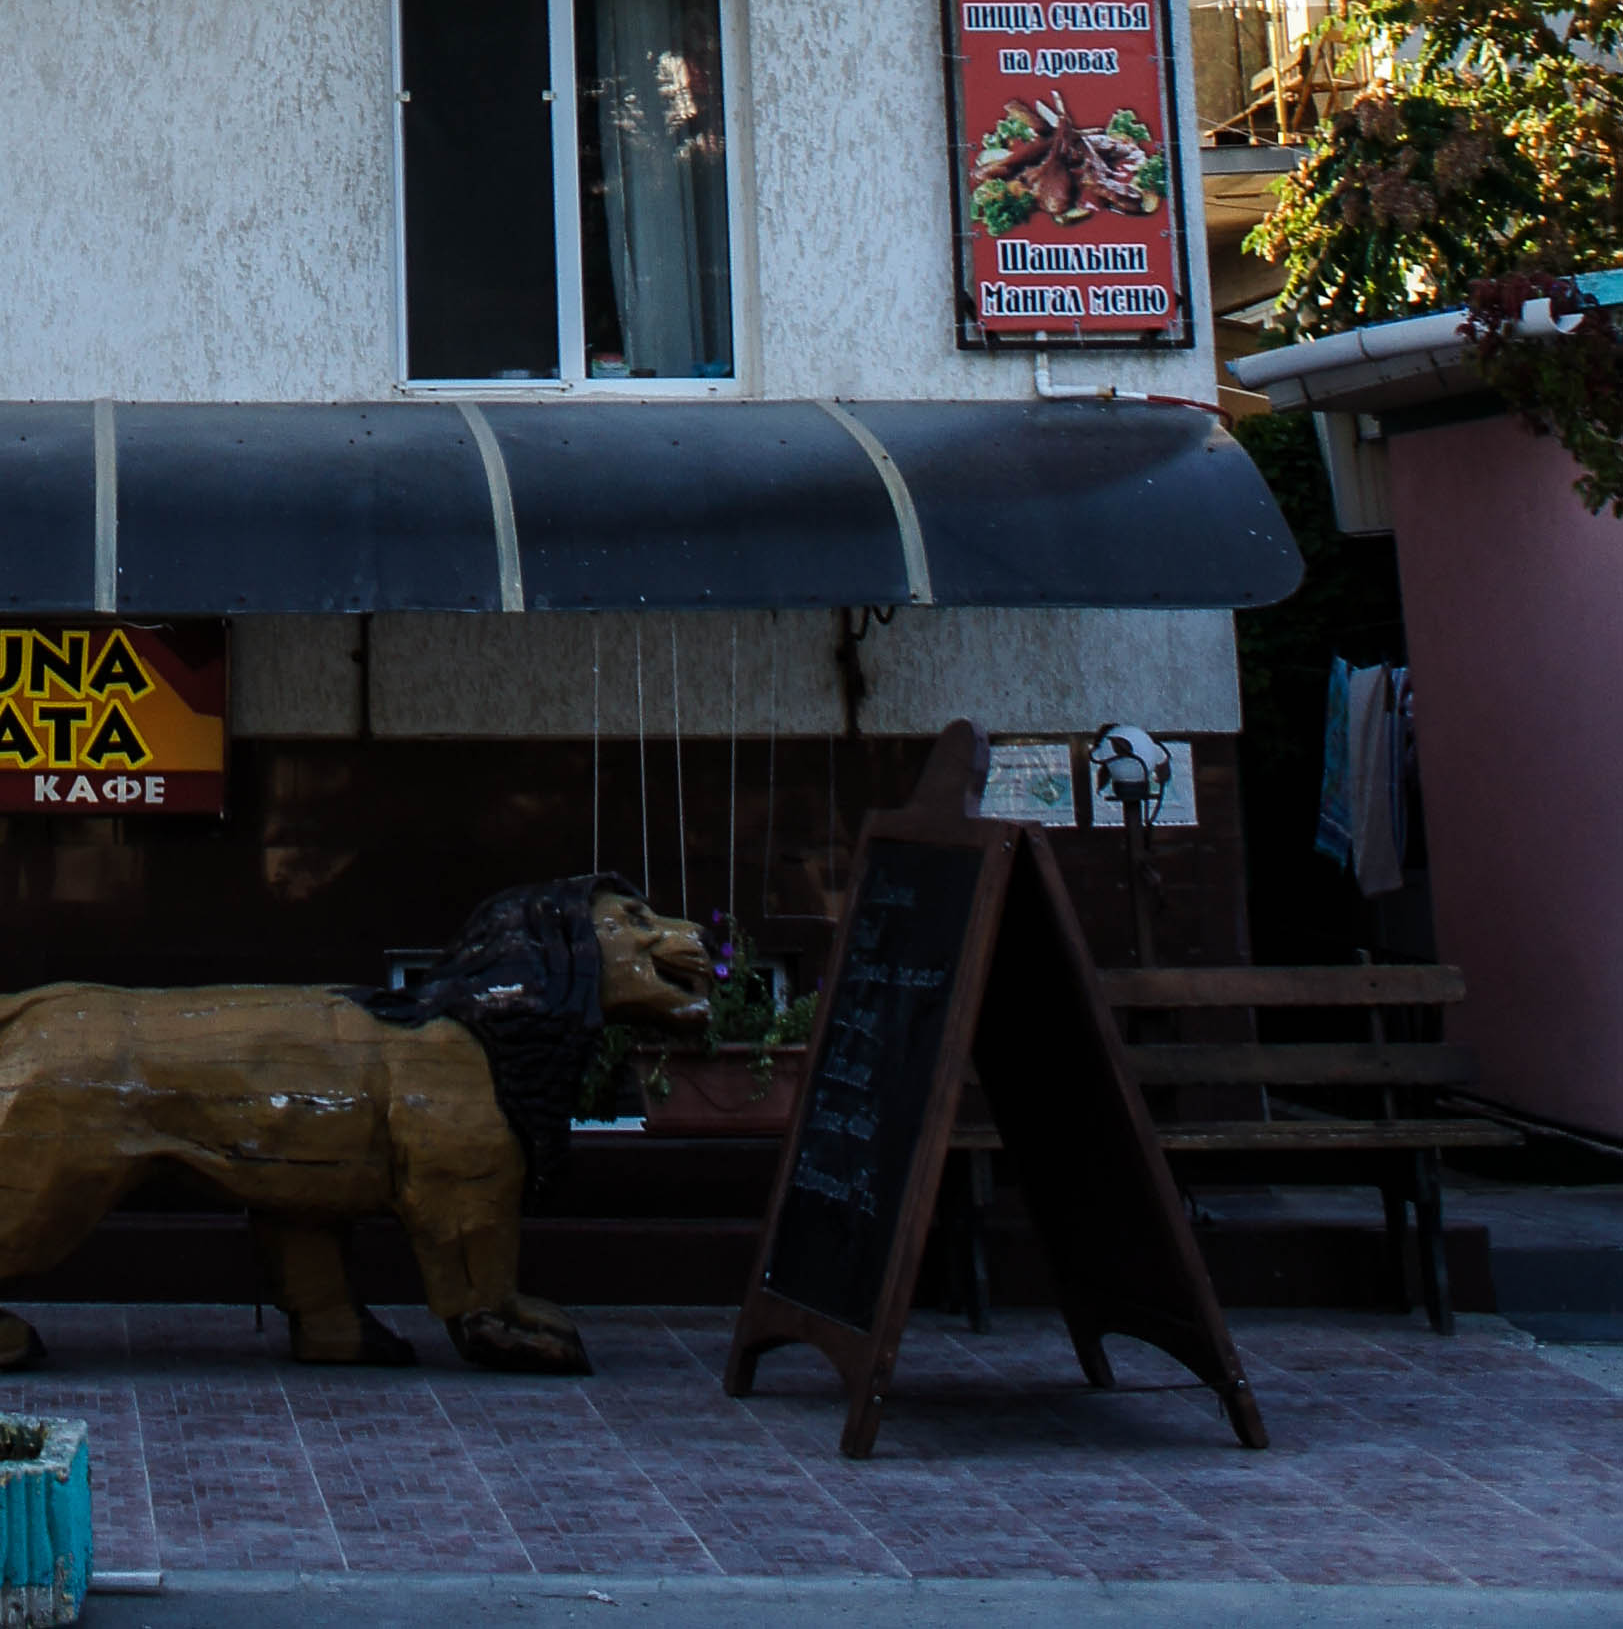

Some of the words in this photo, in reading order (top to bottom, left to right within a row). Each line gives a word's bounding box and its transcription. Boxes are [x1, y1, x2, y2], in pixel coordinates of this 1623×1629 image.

[963, 3, 1046, 34] ПИЦЦА
[1049, 2, 1150, 31] СЧАСТЬЯ
[999, 49, 1032, 74] на
[1034, 48, 1119, 77] дровах
[997, 240, 1148, 274] Шашлыки
[981, 282, 1085, 316] Мангал
[1088, 285, 1169, 315] меню
[34, 775, 166, 804] КАФЕ
